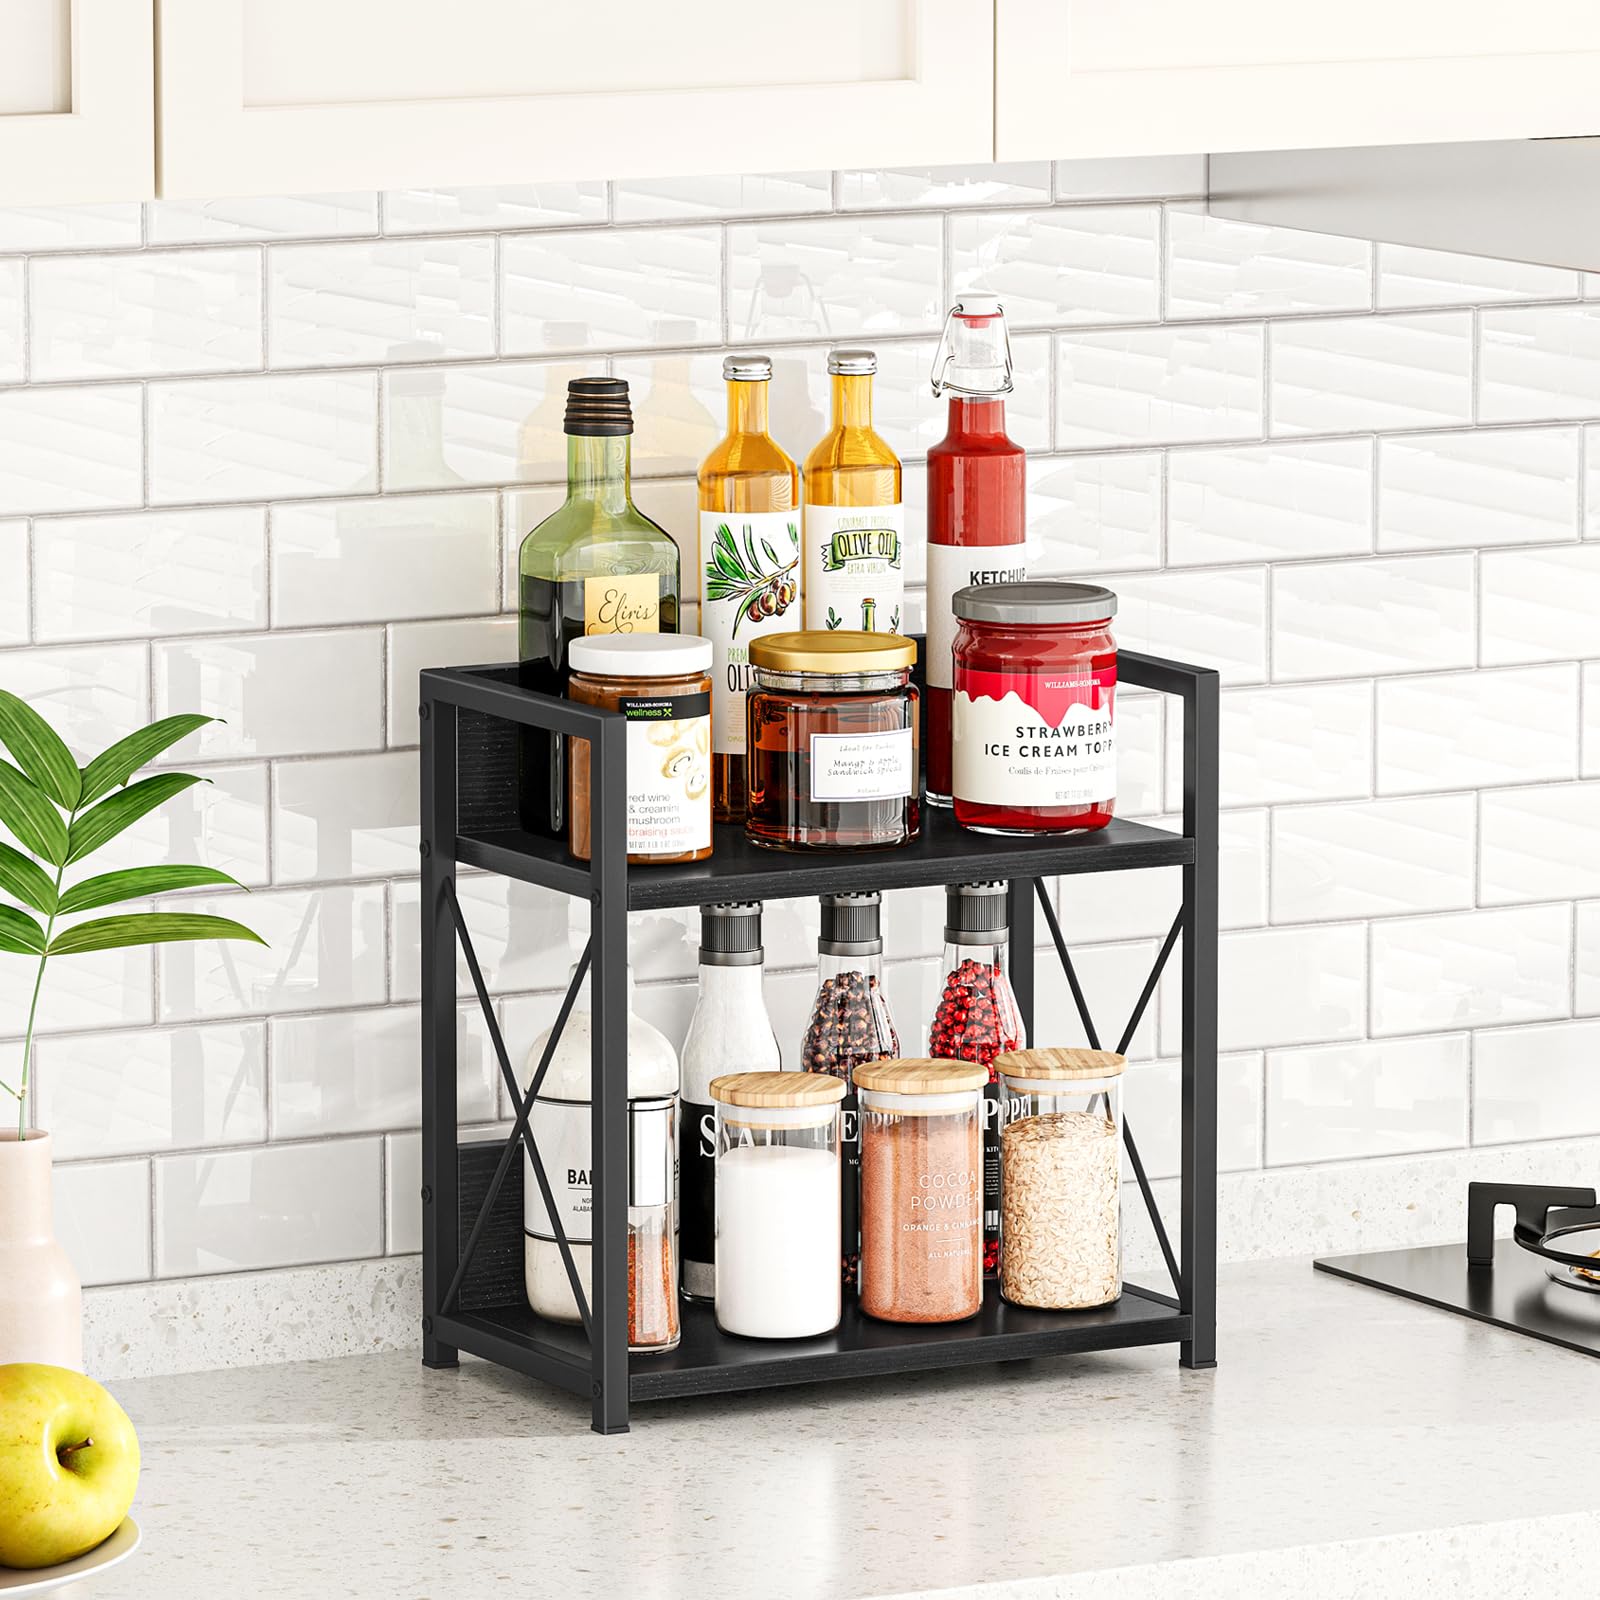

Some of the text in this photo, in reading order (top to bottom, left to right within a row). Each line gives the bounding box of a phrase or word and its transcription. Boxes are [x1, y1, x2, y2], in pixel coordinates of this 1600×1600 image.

[838, 532, 892, 557] OLIVE OIL
[728, 648, 747, 661] PREM
[626, 709, 662, 717] wellness
[1016, 721, 1112, 739] STRAWBERRY
[985, 739, 1112, 757] ICE CREAM TOPP
[1008, 766, 1032, 776] Coulis
[628, 793, 671, 802] red wine
[628, 804, 636, 813] &
[628, 816, 681, 825] mushroom
[628, 827, 667, 838] braising
[920, 1171, 976, 1189] COCOA
[911, 1191, 980, 1210] POWDER
[903, 1223, 940, 1232] ORANGE
[943, 1223, 949, 1231] &
